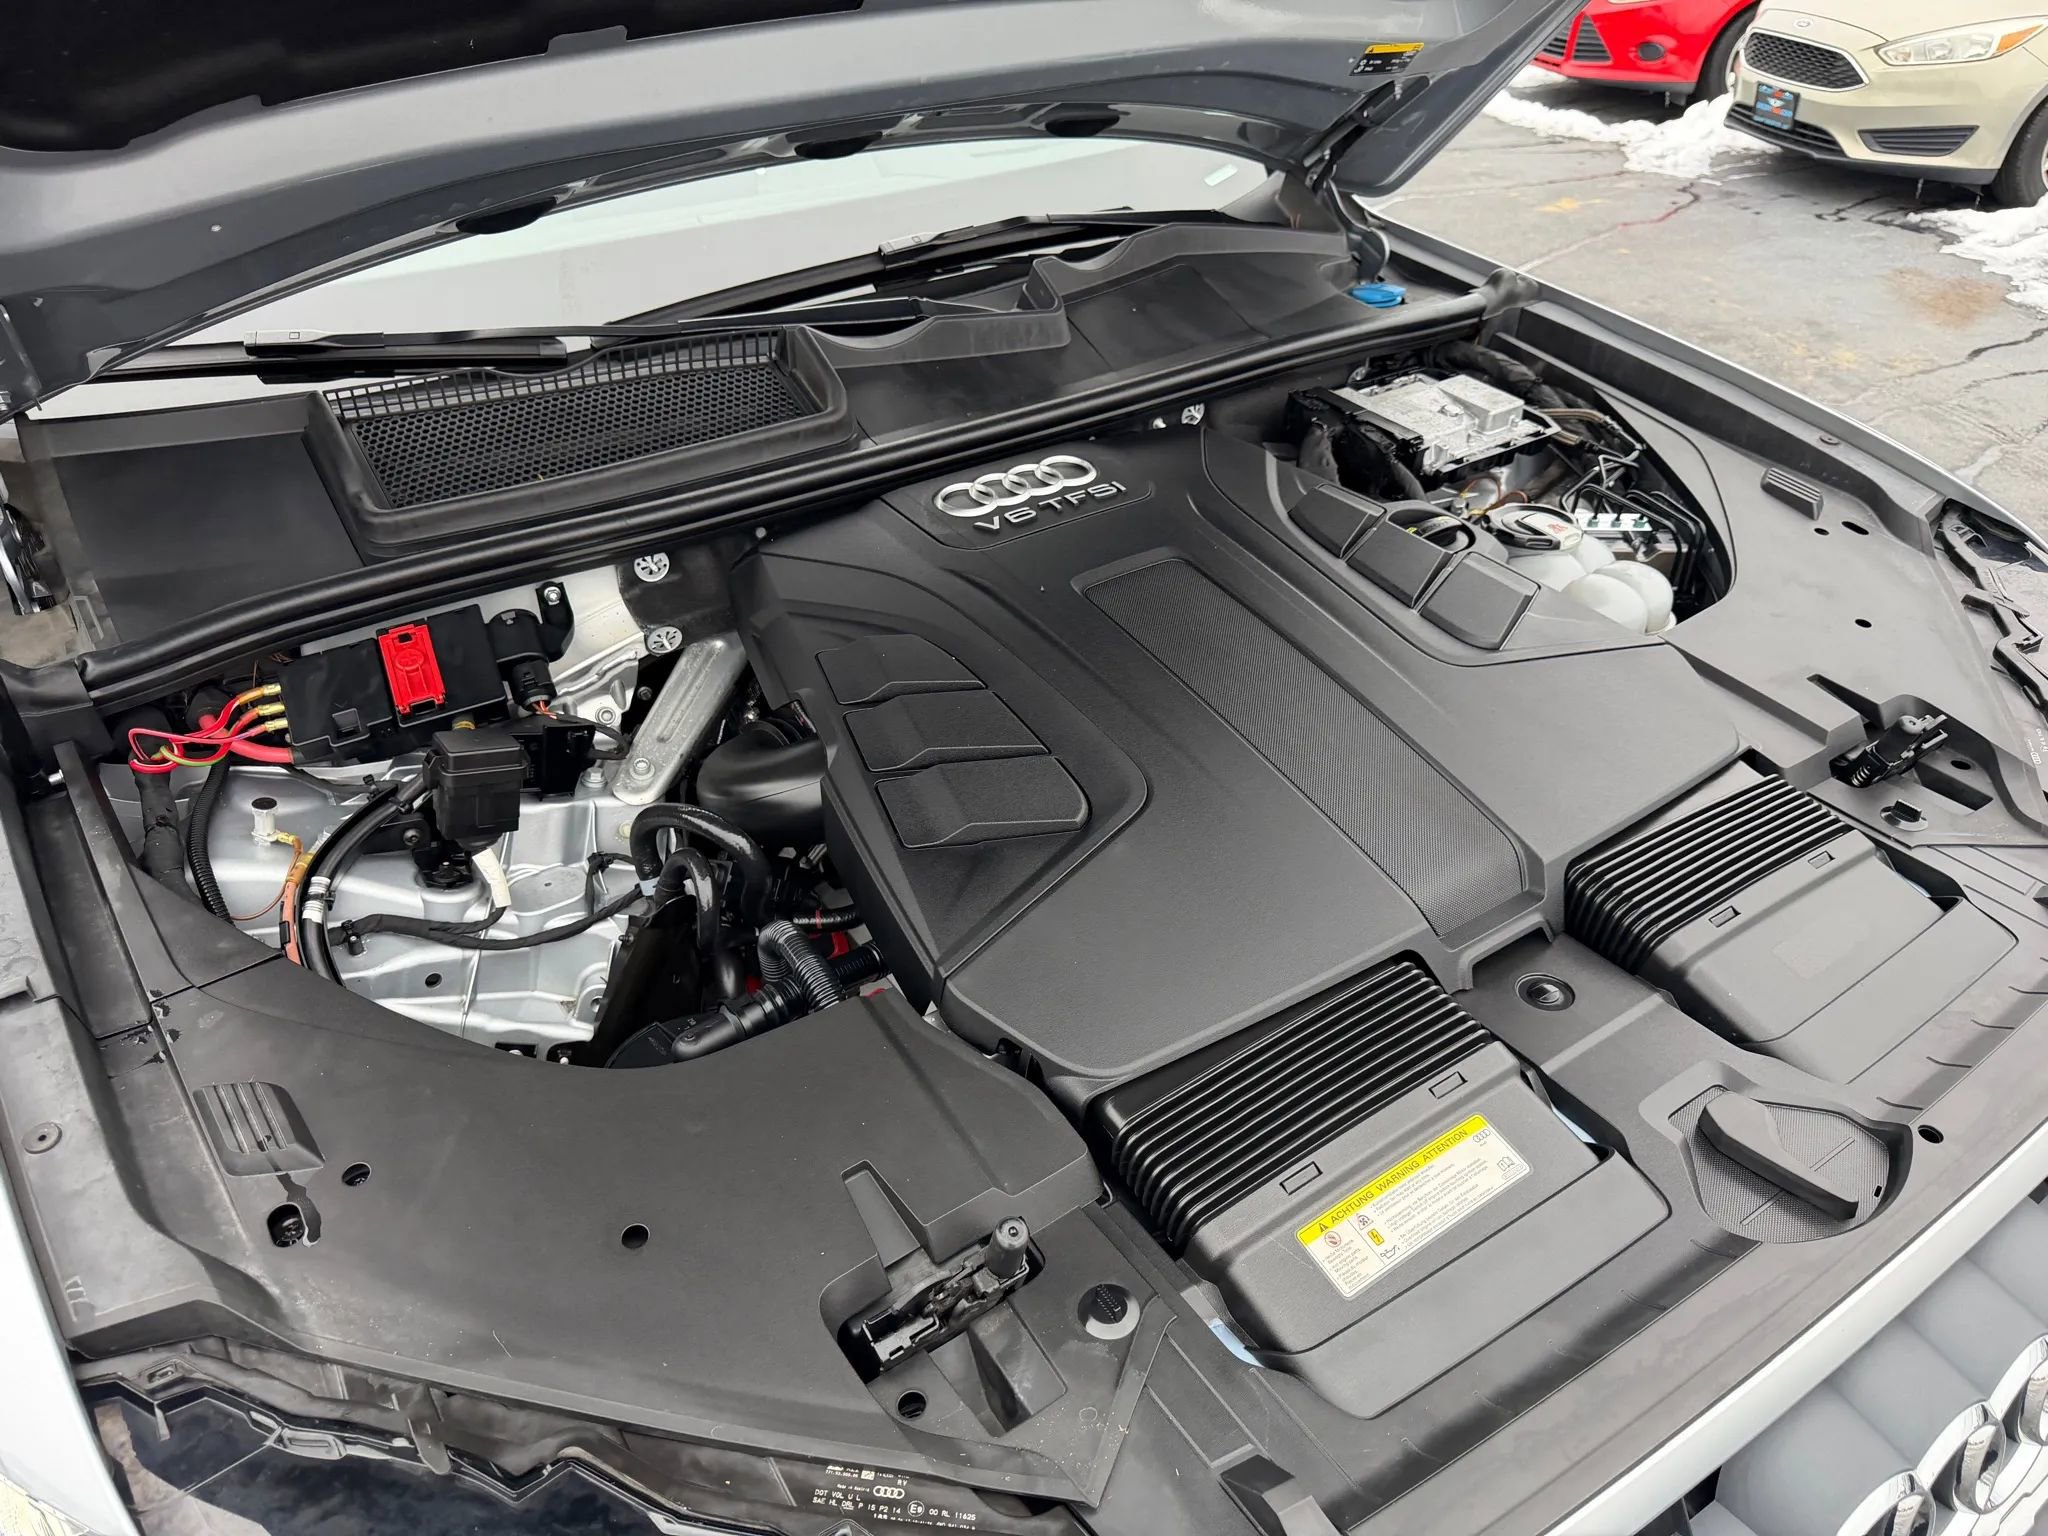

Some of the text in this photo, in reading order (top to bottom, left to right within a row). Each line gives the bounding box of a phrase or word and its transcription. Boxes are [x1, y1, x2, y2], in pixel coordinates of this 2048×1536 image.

[973, 481, 1126, 530] V6 TFSI
[1331, 1129, 1468, 1224] ACHTUNG WARNING ATTENTION
[812, 1497, 826, 1505] SAE
[879, 1505, 889, 1513] P2
[910, 1504, 923, 1514] E9
[814, 1489, 828, 1497] DOT
[832, 1491, 844, 1499] VOL
